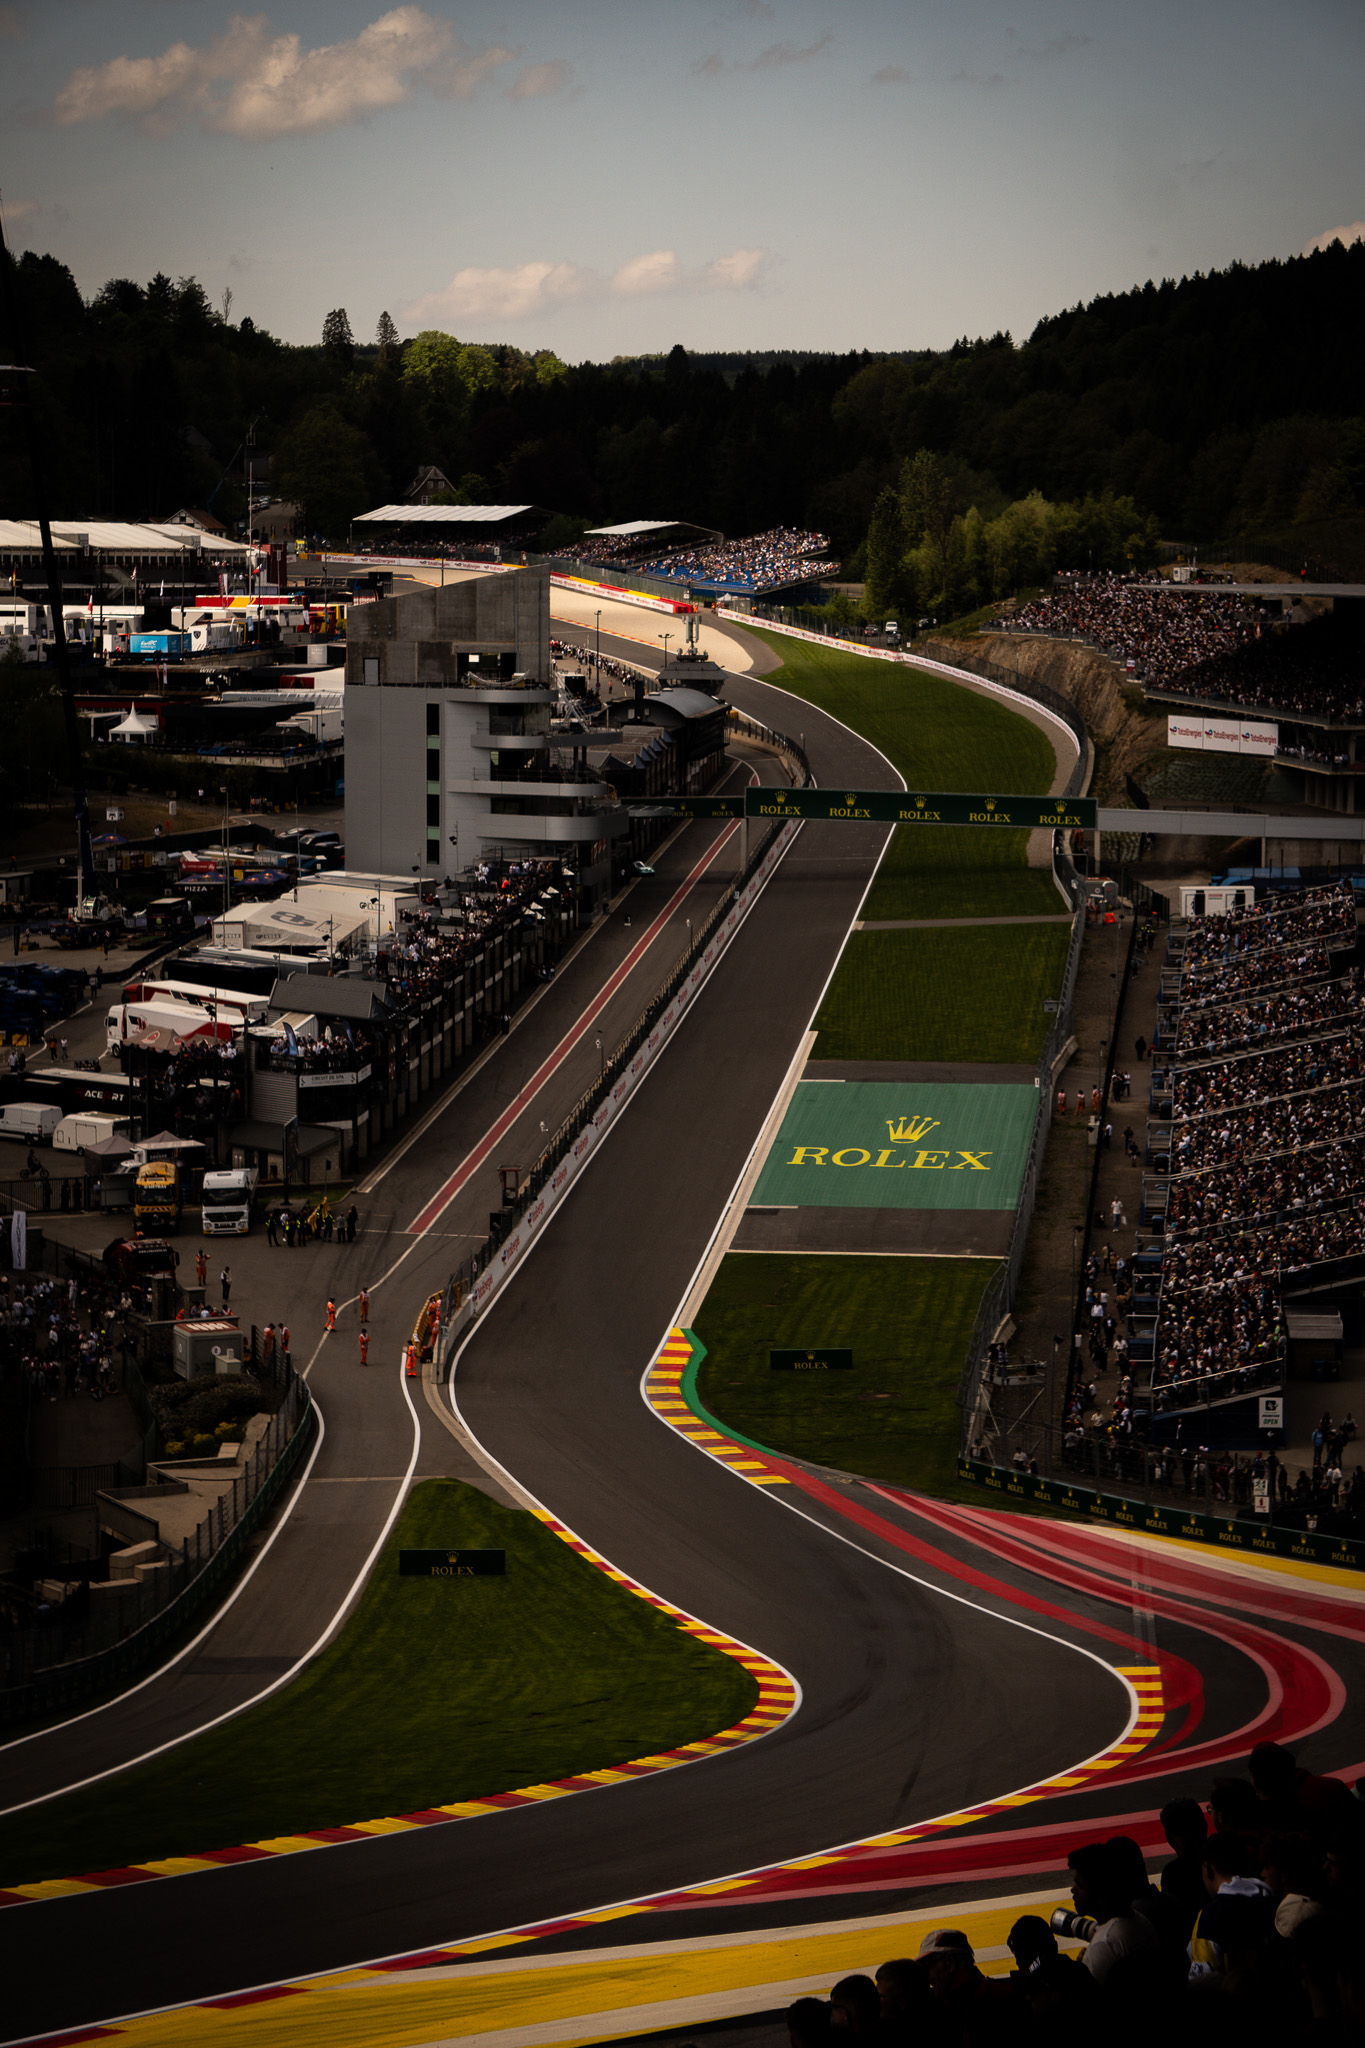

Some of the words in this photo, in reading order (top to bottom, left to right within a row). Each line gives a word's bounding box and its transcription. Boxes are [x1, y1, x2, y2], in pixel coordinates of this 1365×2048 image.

[1178, 727, 1202, 739] TotalEnergies
[1213, 730, 1239, 742] TotalEnergies
[1250, 733, 1277, 745] TotalEnergies
[759, 805, 801, 816] ROLEX
[829, 807, 871, 818] ROLEX
[899, 810, 941, 821] ROLEX
[969, 812, 1011, 823] ROLEX
[1039, 814, 1081, 825] ROLEX
[786, 1146, 993, 1170] ROLEX
[794, 1362, 829, 1370] ROLEX
[959, 1469, 976, 1480] ROLEX
[985, 1477, 1001, 1488] ROLEX
[1007, 1483, 1024, 1494] ROLEX
[1033, 1490, 1051, 1502] ROLEX
[1061, 1497, 1079, 1509] ROLEX
[1090, 1505, 1108, 1517] ROLEX
[1115, 1511, 1135, 1523] ROLEX
[1145, 1518, 1168, 1530] ROLEX
[1181, 1525, 1205, 1537] ROLEX
[1219, 1532, 1243, 1544] ROLEX
[1252, 1538, 1276, 1550] ROLEX
[1291, 1545, 1316, 1557] ROLEX
[1332, 1552, 1356, 1564] ROLEX
[431, 1566, 475, 1576] ROLEX
